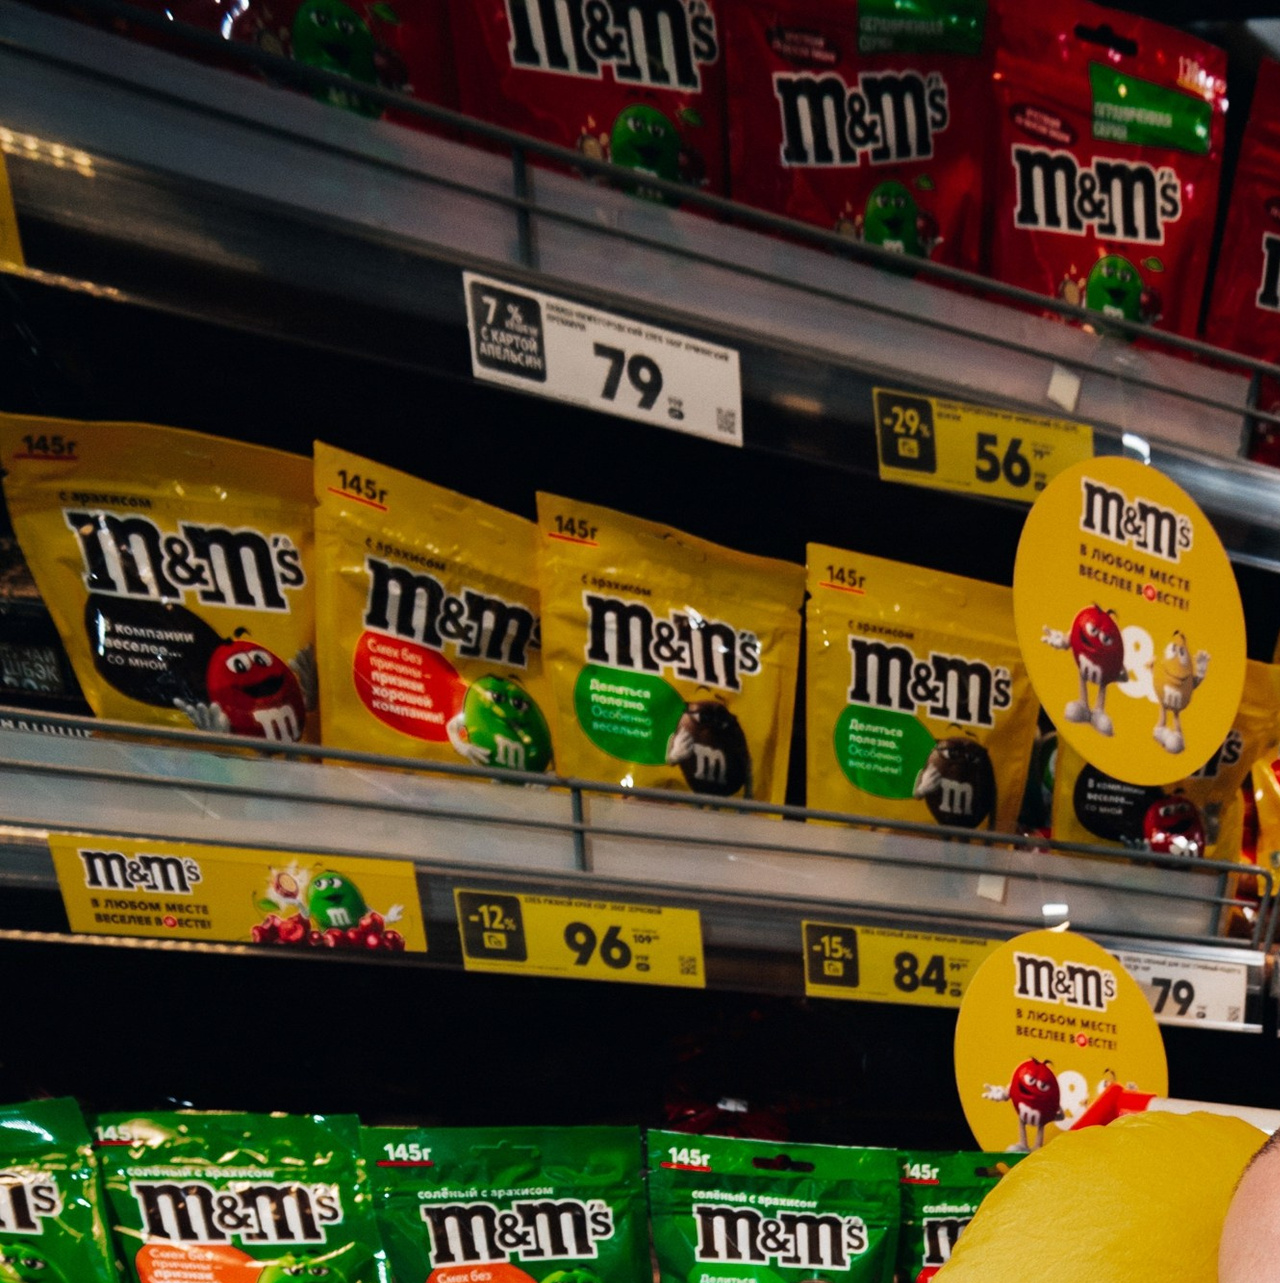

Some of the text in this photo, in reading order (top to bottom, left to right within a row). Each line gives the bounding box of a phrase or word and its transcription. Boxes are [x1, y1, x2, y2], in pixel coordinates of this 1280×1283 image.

[507, 0, 718, 93] m&m's
[773, 71, 949, 168] m&m's
[1011, 143, 1182, 246] m&m's
[481, 295, 498, 325] 7
[490, 329, 538, 355] КАРТОЙ
[479, 341, 542, 371] АПЕЛЬСИН
[593, 342, 664, 411] 79
[22, 434, 76, 455] 145г
[975, 432, 1031, 488] 56
[337, 469, 388, 503] 145г
[75, 490, 155, 509] арахисом
[554, 514, 599, 541] 145г
[1080, 476, 1193, 563] m&m's
[62, 507, 307, 614] m&m's
[375, 543, 447, 573] арахисом
[1080, 544, 1191, 592] В ЛЮБОМ МЕСТЕ
[591, 576, 653, 598] арахисом
[826, 564, 867, 588] 145г
[1079, 564, 1133, 593] ВЕСЕЛЕЕ
[114, 623, 195, 644] компании
[582, 590, 762, 693] m&m's
[856, 621, 915, 640] арахисом
[104, 638, 182, 657] веселее...
[106, 653, 125, 666] со
[367, 639, 423, 666] Смех без
[369, 656, 422, 679] причины
[371, 670, 426, 694] признак
[589, 678, 651, 700] Делиться
[848, 634, 1013, 729] m&m's
[371, 686, 433, 710] хорошей
[590, 693, 648, 713] полезно.
[372, 699, 446, 726] компании!
[591, 704, 652, 726] Особенно
[592, 721, 653, 741] весельем!
[849, 718, 904, 738] Делиться
[848, 743, 903, 763] Особенно
[849, 733, 899, 751] полезно.
[78, 848, 202, 895] m&m's
[94, 912, 155, 927] ВЕСЕЛЕЕ
[104, 899, 161, 914] ЛЮБОМ
[165, 902, 210, 916] МЕСТЕ
[469, 904, 517, 931] -12%
[564, 921, 632, 969] 96
[812, 935, 853, 959] -15%
[893, 950, 948, 995] 84
[1013, 951, 1118, 1012] m&m's
[1151, 977, 1195, 1017] 79
[1016, 1008, 1118, 1035] В ЛЮБОМ МЕСТЕ
[1016, 1025, 1066, 1044] ВЕСЕЛЕЕ
[384, 1143, 431, 1161] 145г
[668, 1147, 711, 1166] 145г
[204, 1168, 275, 1181] арахисом
[902, 1163, 939, 1180] 145г
[417, 1187, 478, 1200] солёный
[490, 1186, 554, 1199] арахисом
[691, 1189, 747, 1203] солёный
[758, 1195, 818, 1209] арахисом
[129, 1180, 344, 1245] m&m's
[922, 1203, 969, 1214] солёный
[420, 1198, 615, 1268] m&m's
[692, 1203, 868, 1271] m&m's
[149, 1248, 185, 1260] Смех
[150, 1260, 213, 1272] причины
[153, 1270, 214, 1282] признак
[470, 1269, 492, 1282] без
